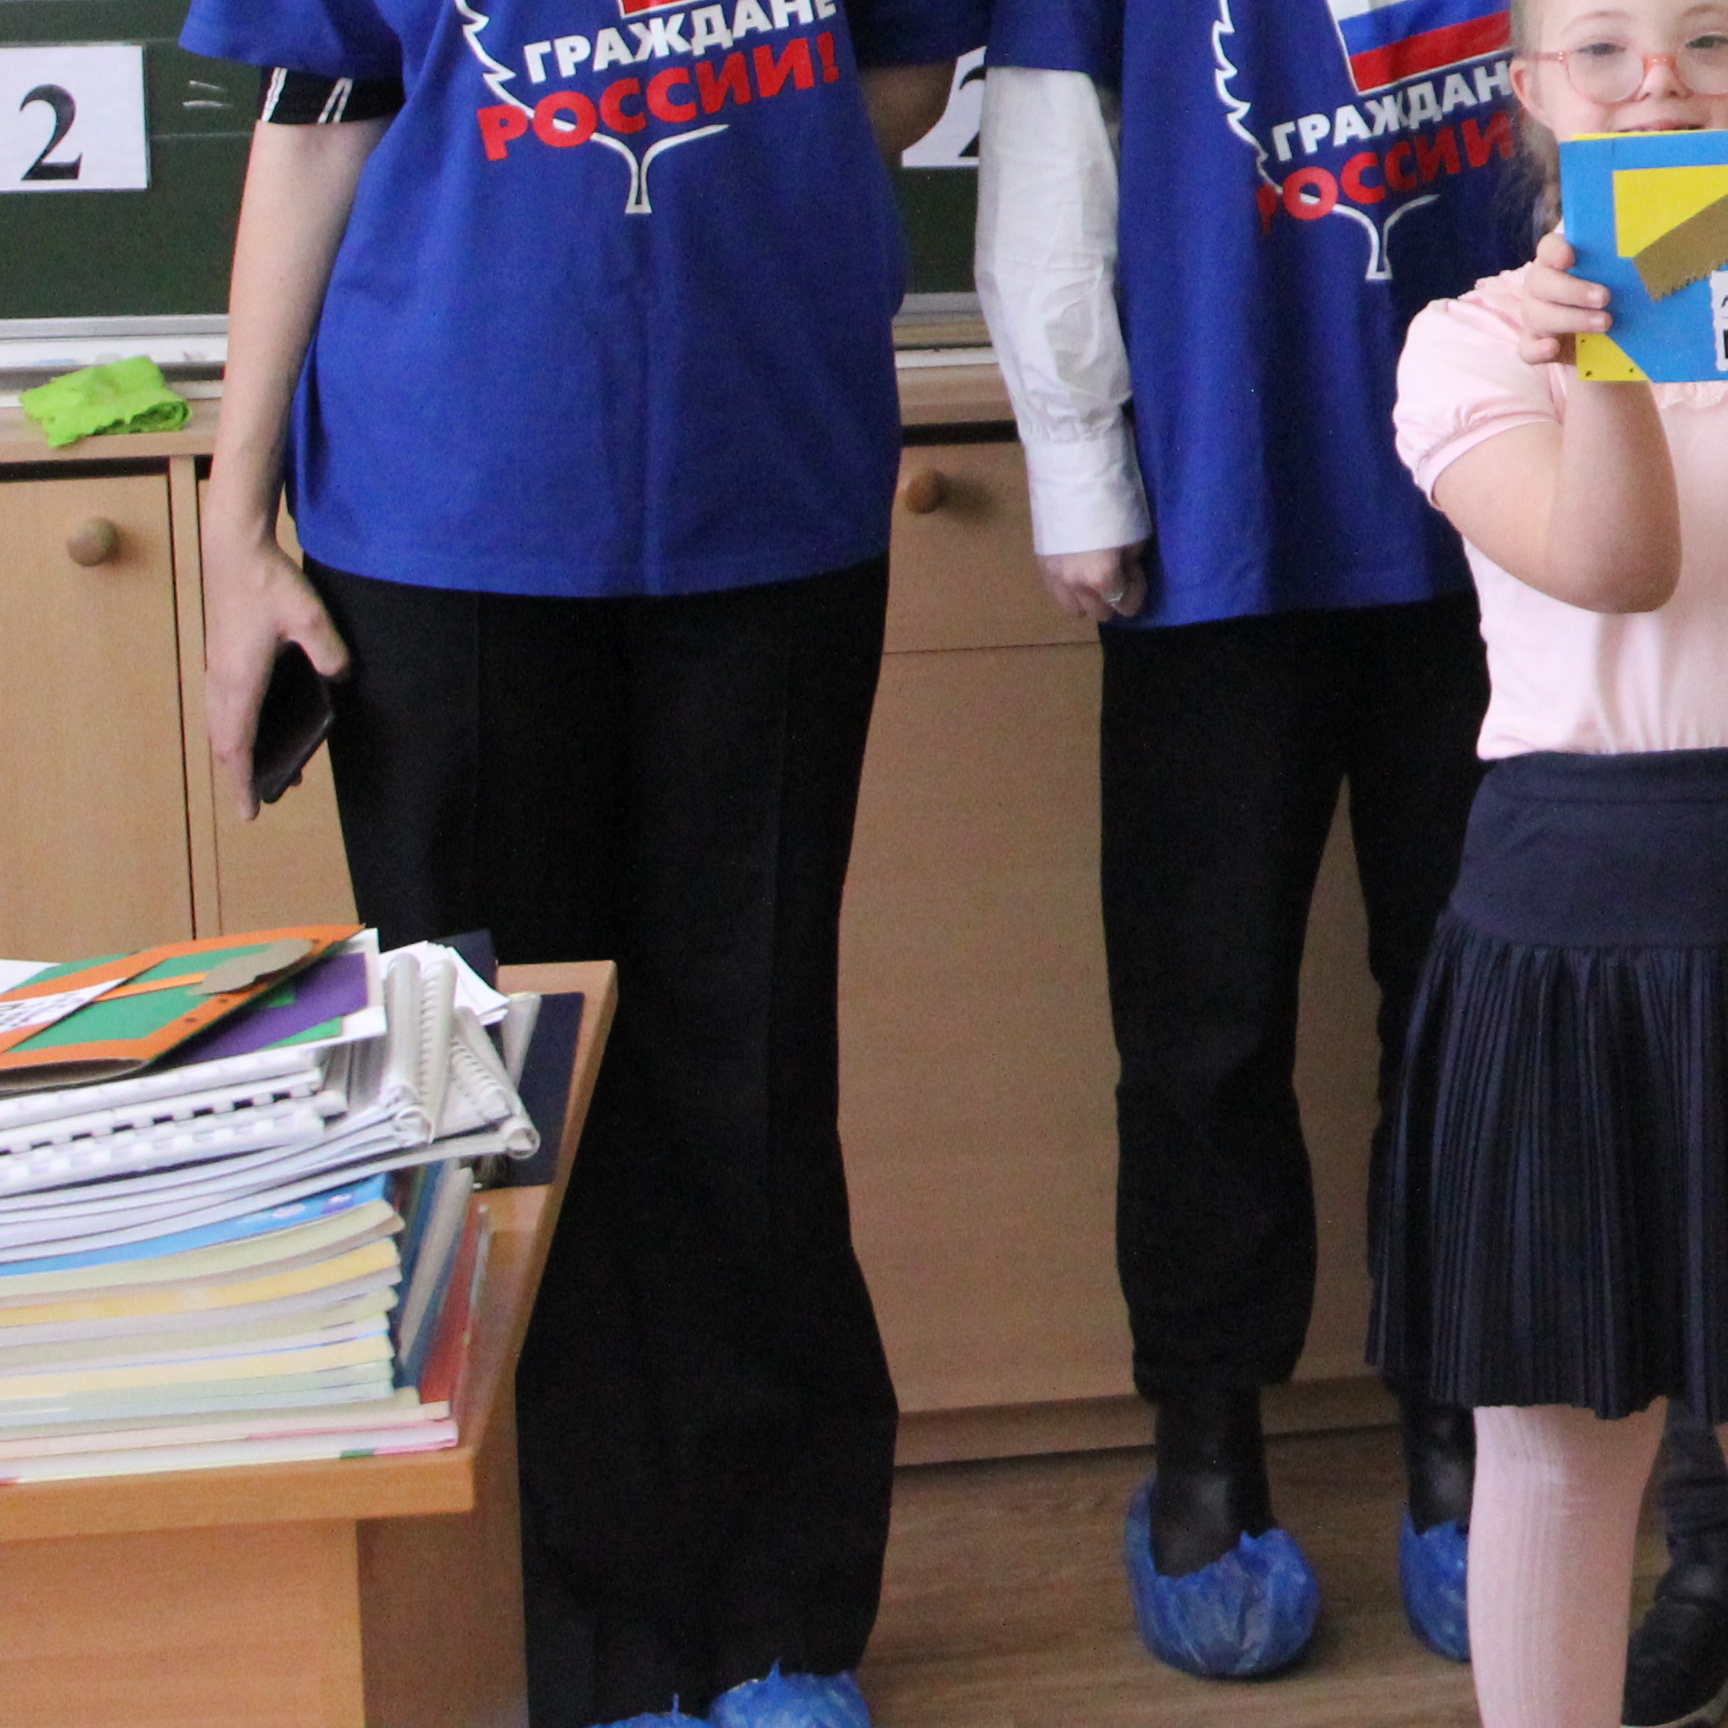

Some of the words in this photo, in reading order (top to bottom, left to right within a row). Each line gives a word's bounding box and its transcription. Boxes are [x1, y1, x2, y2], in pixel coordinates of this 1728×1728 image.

[20, 84, 83, 181] 2
[477, 29, 839, 161] РОССИИ!
[1271, 60, 1512, 162] ГРАЖДАН
[1256, 110, 1515, 237] РОССИИ
